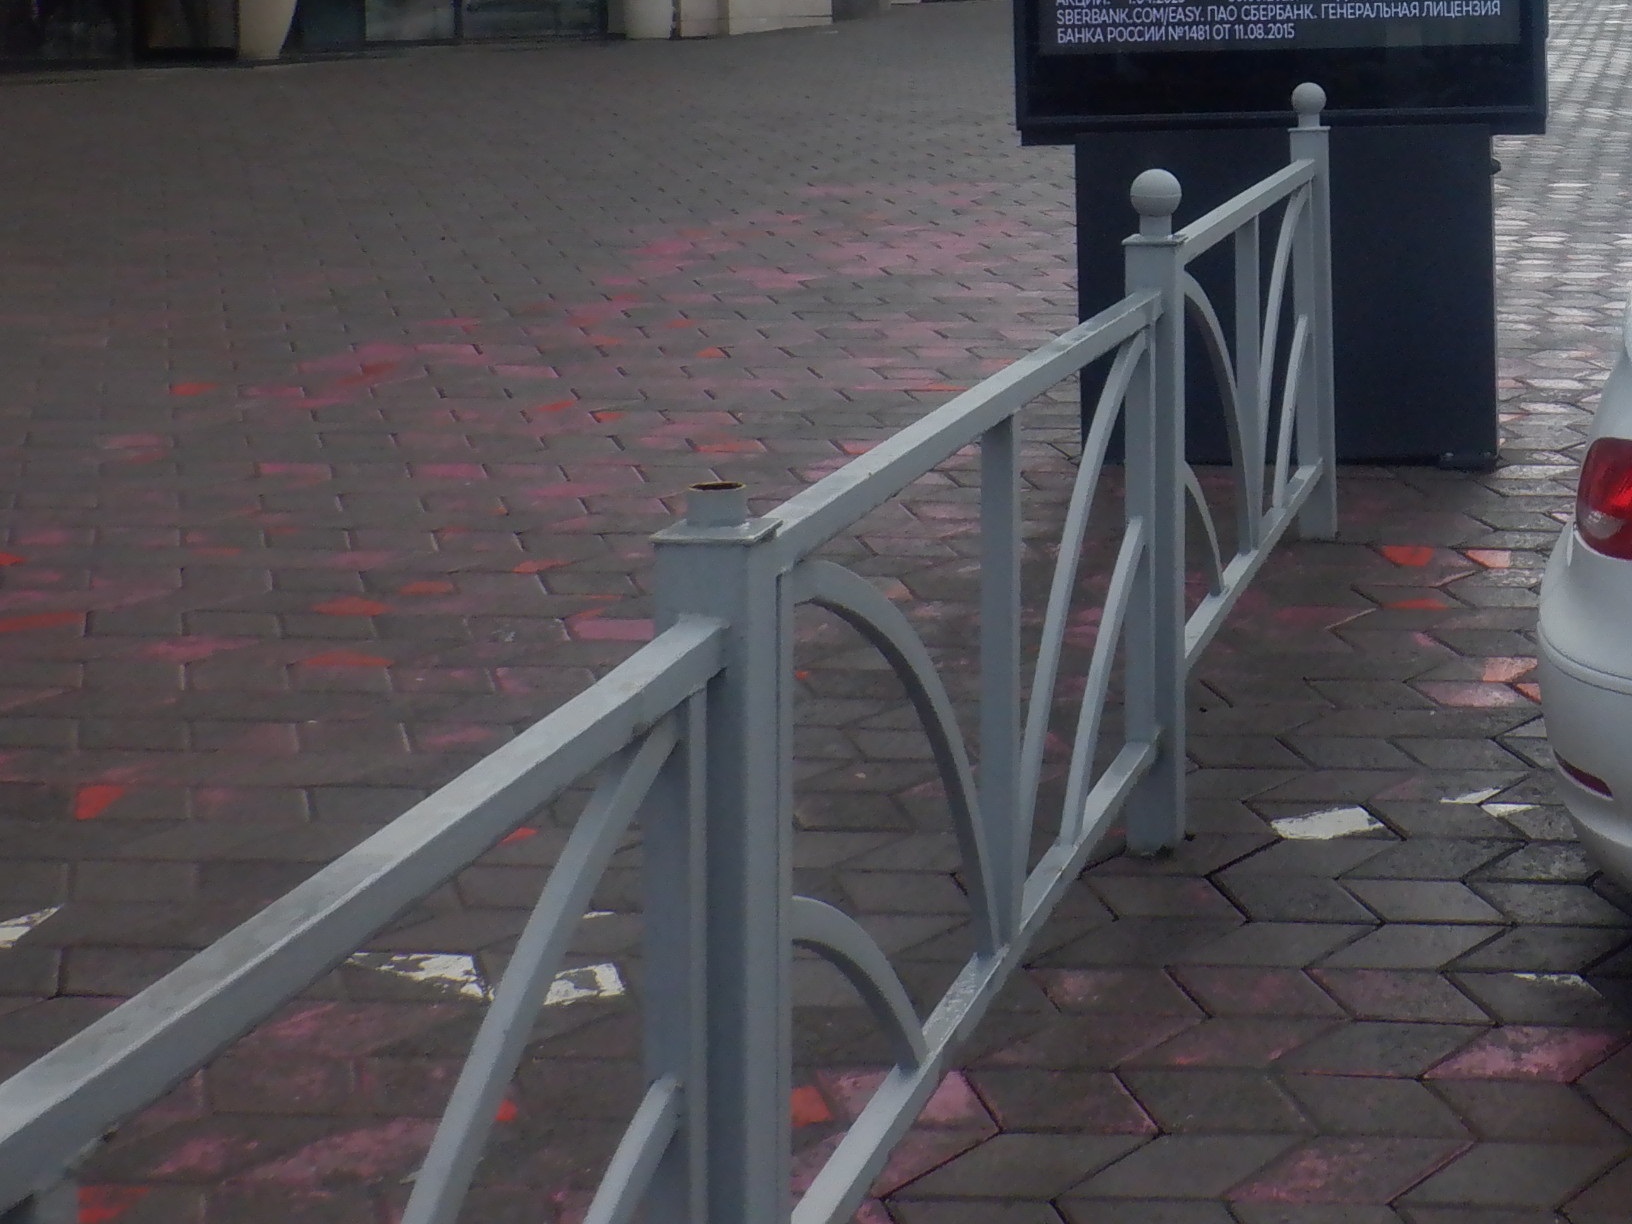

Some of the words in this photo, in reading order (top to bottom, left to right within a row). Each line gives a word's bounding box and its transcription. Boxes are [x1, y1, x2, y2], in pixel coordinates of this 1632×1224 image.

[1056, 6, 1204, 25] SBERBANK.COM/EASY.
[1207, 5, 1237, 21] ПАО
[1241, 3, 1317, 20] СБЕРБАНК.
[1321, 2, 1419, 19] ГЕНЕРАЛЬНАЯ
[1422, 0, 1500, 18] ЛИЦЕНЗИЯ
[1057, 27, 1104, 44] БАНКА
[1107, 25, 1166, 42] РОССИИ
[1213, 24, 1232, 40] ОТ
[1234, 23, 1295, 39] 11.08.2015
